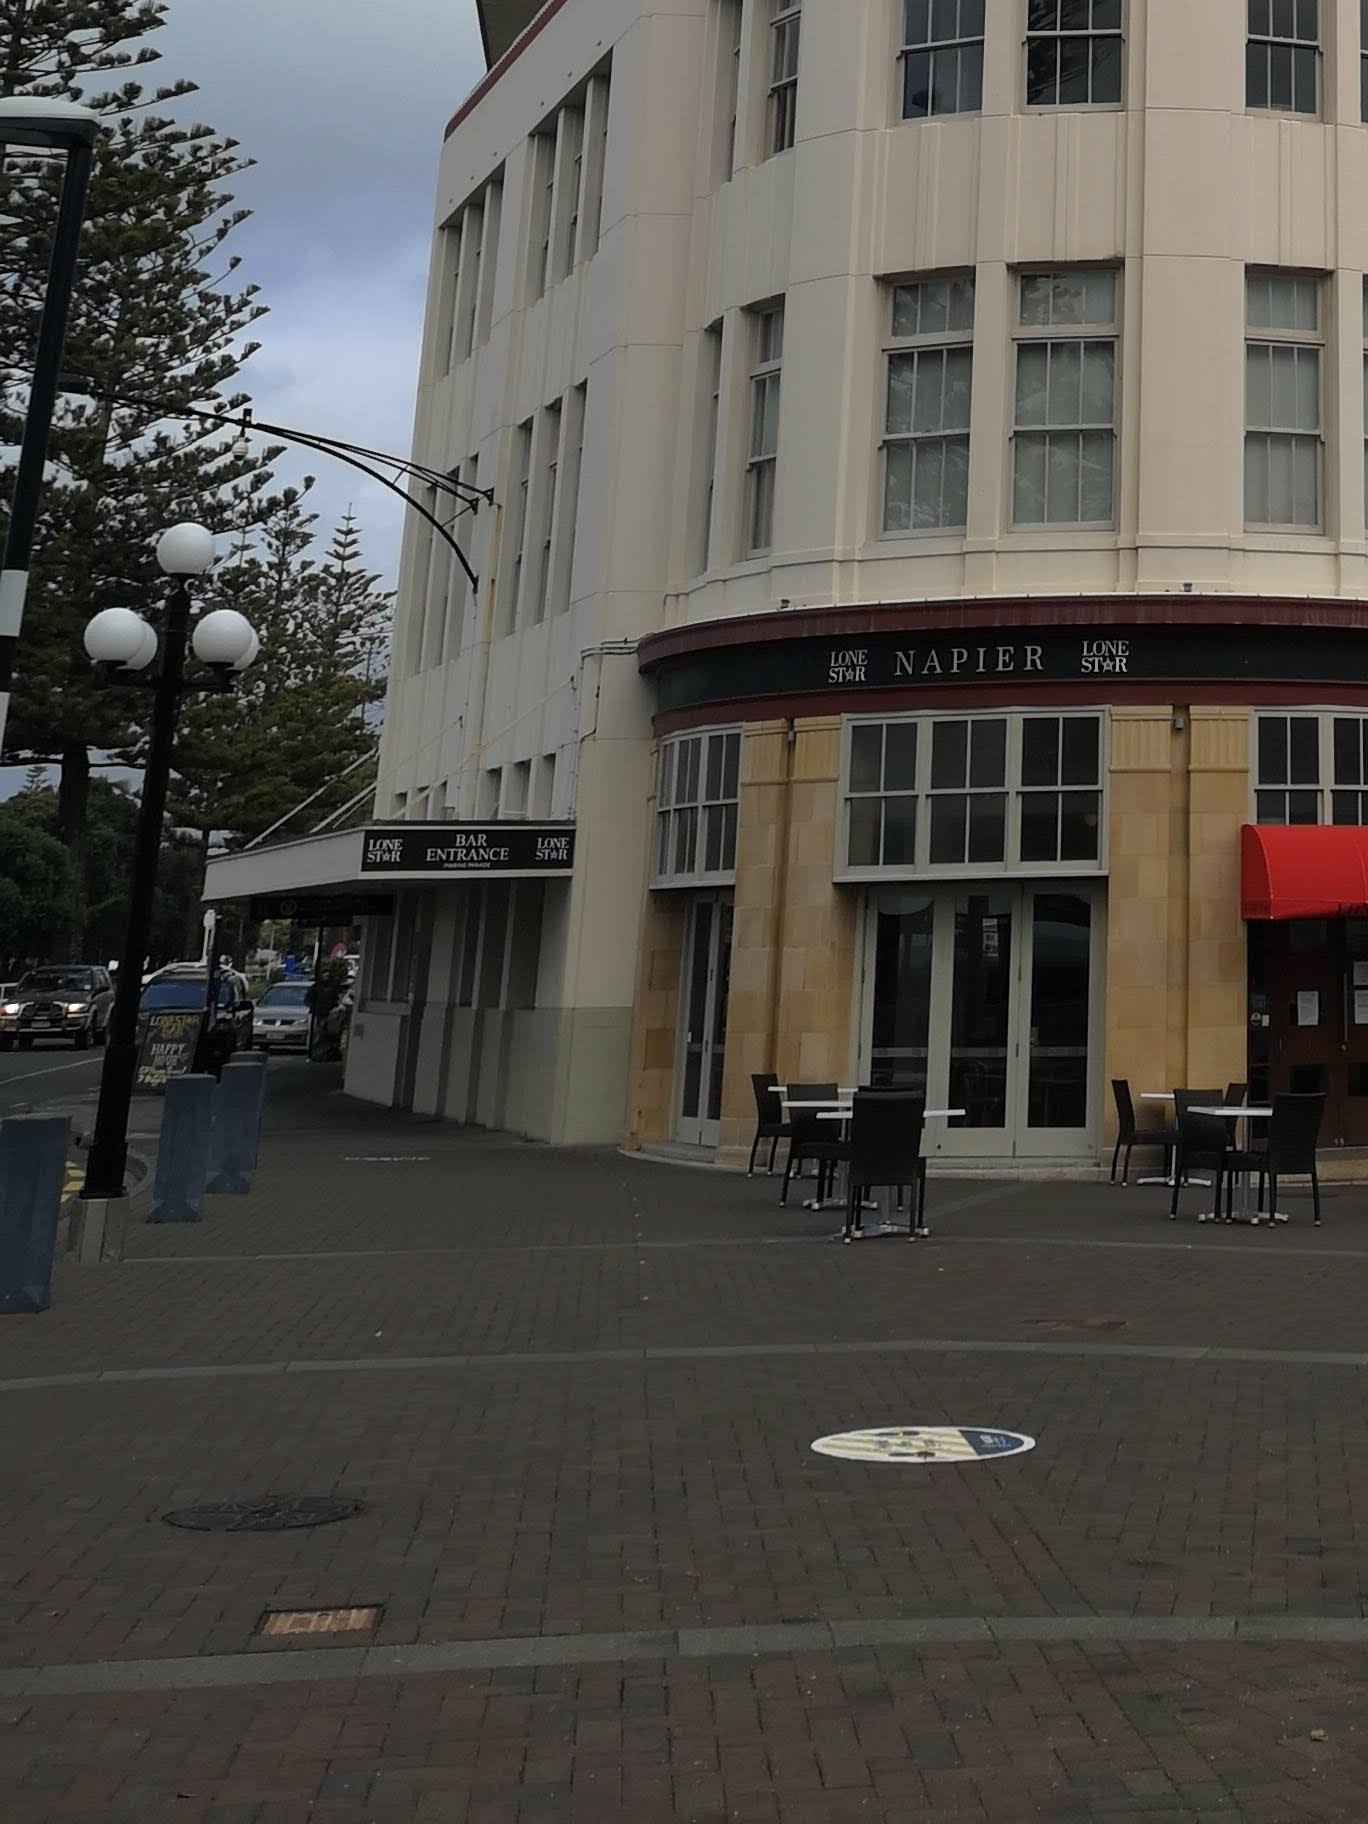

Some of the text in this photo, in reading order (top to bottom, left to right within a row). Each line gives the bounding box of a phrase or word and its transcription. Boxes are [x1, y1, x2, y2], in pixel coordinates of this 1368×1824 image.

[1082, 640, 1129, 657] LONE
[830, 649, 868, 666] LONE
[894, 645, 1044, 676] NAPIER
[368, 838, 403, 851] LONE
[455, 833, 487, 847] BAR
[537, 837, 570, 849] LONE
[426, 847, 510, 861] ENTRANCE
[150, 1043, 186, 1055] HAPPY
